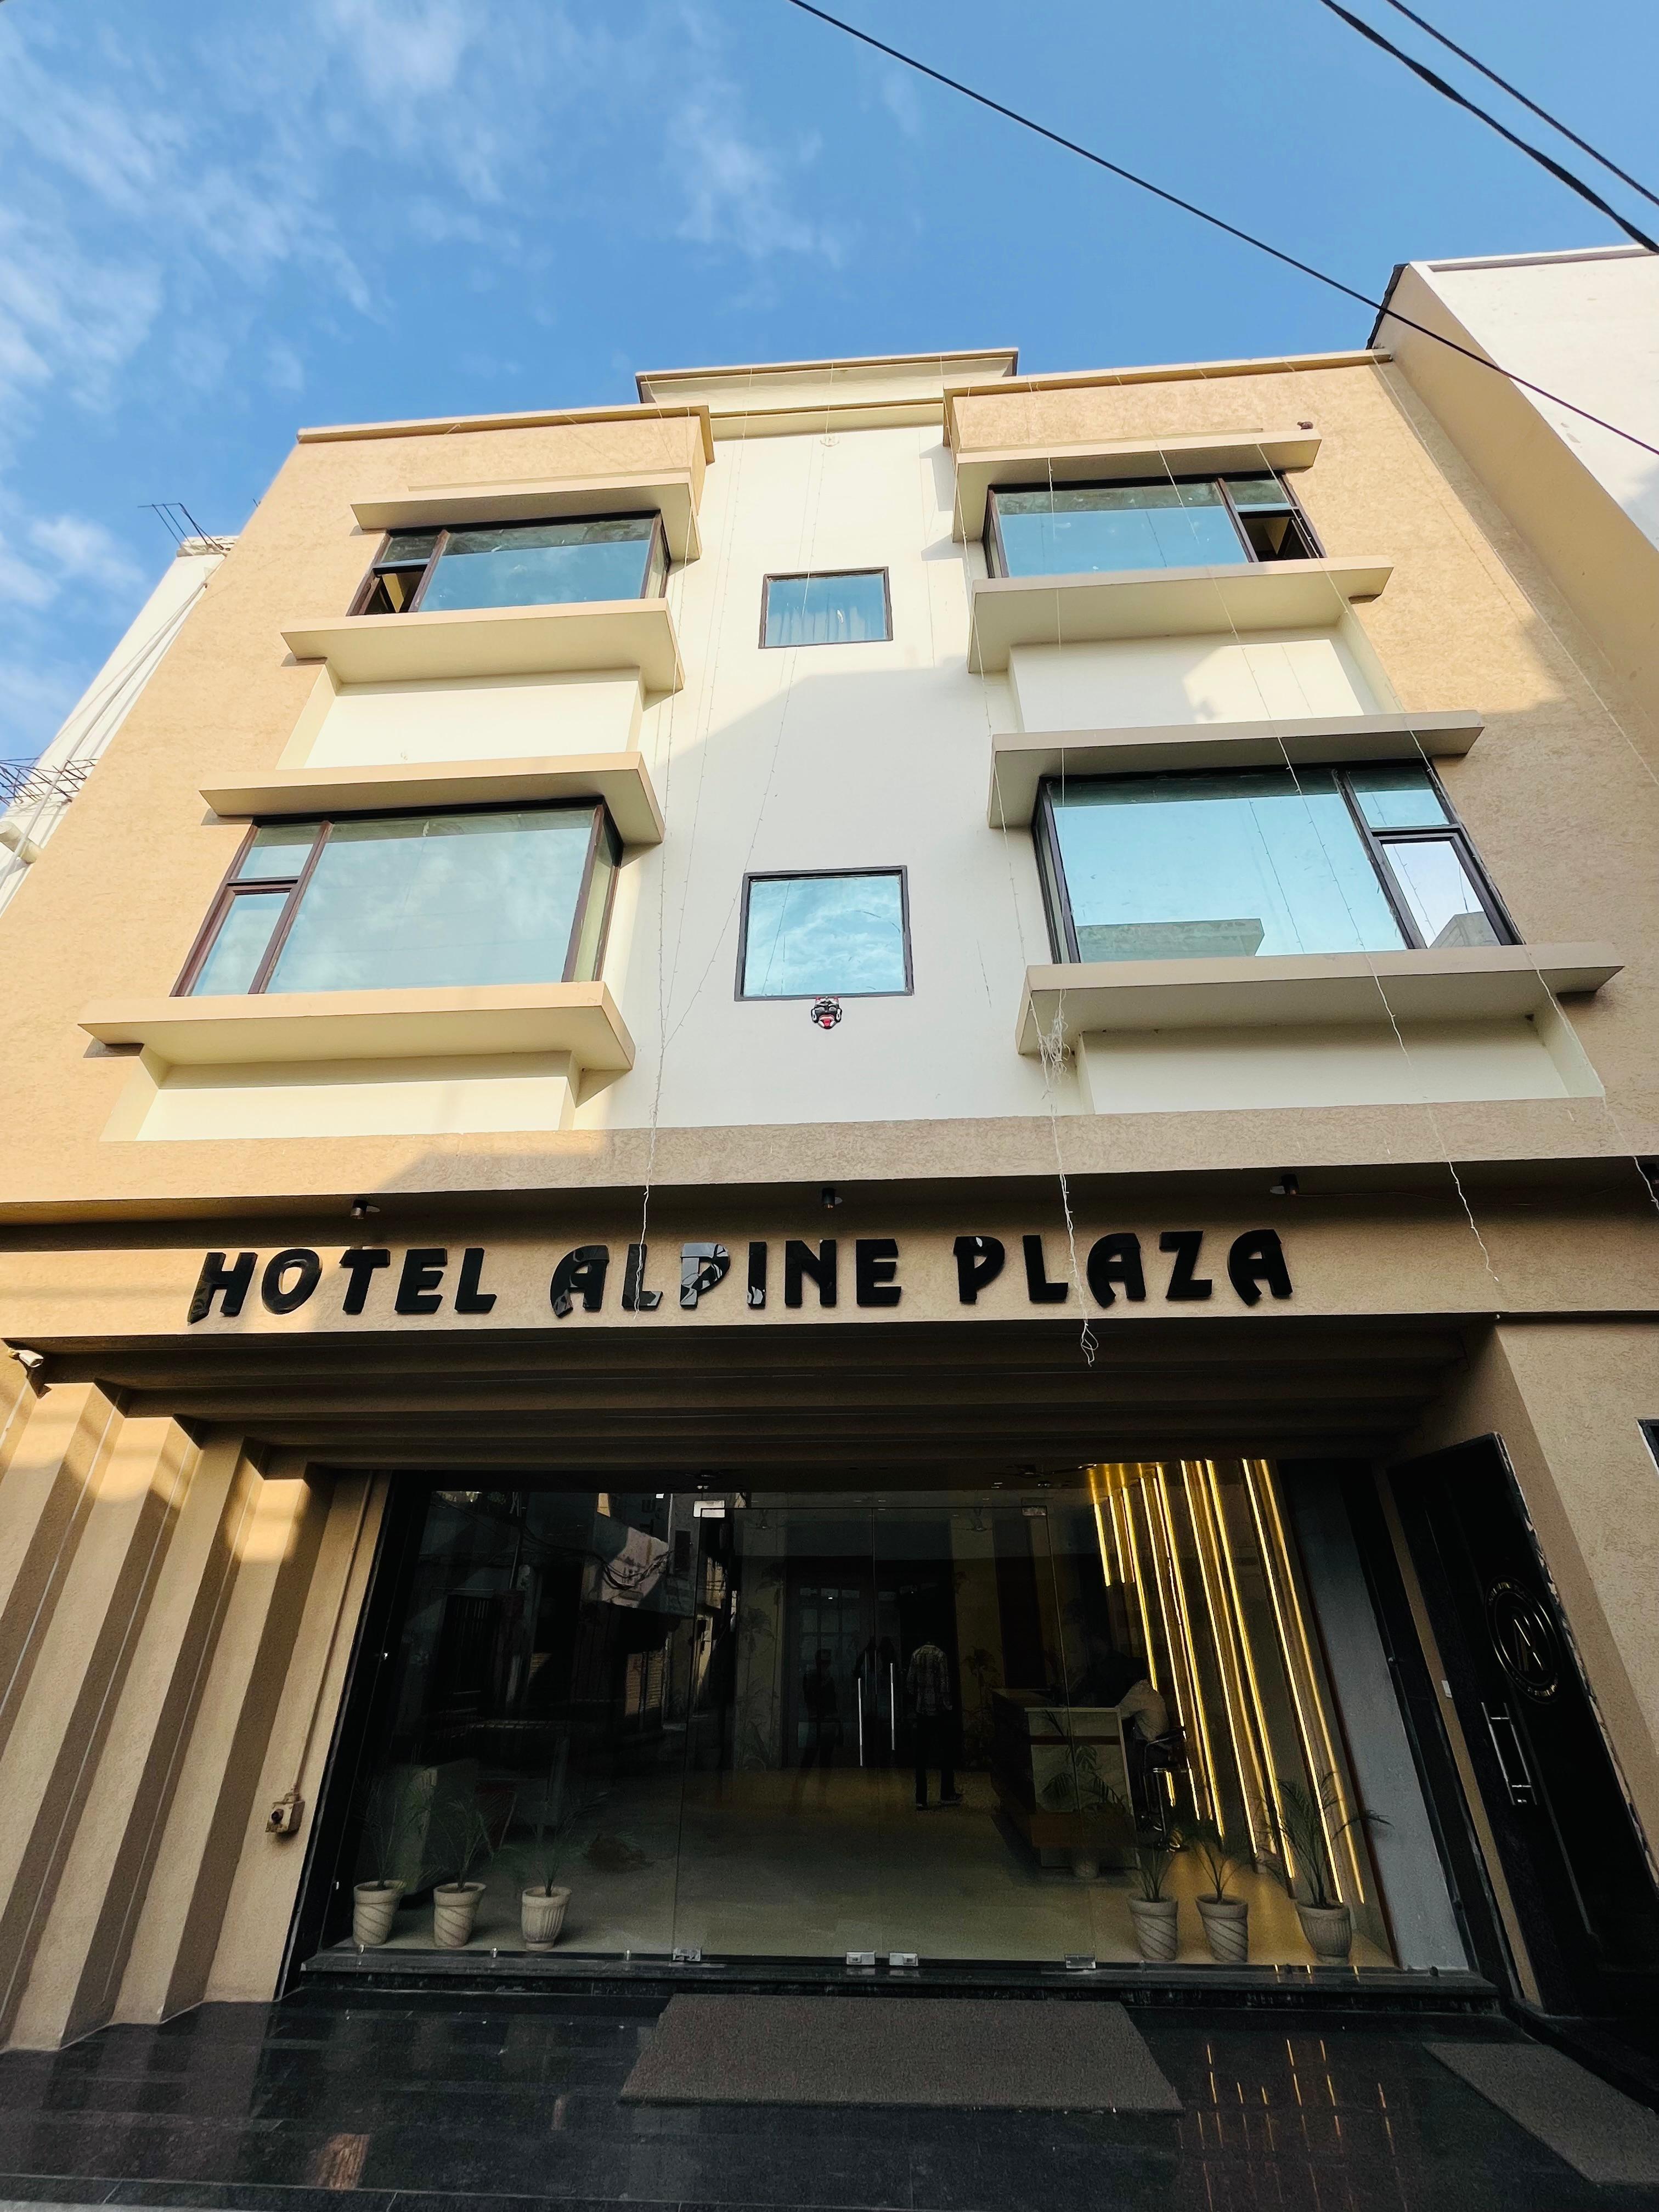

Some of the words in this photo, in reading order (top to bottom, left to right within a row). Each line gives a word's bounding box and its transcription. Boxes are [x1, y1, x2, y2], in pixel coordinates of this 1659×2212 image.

[187, 1246, 498, 1324] HOTEL
[550, 1238, 902, 1318] ALPINE
[953, 1228, 1293, 1308] PLAZA
